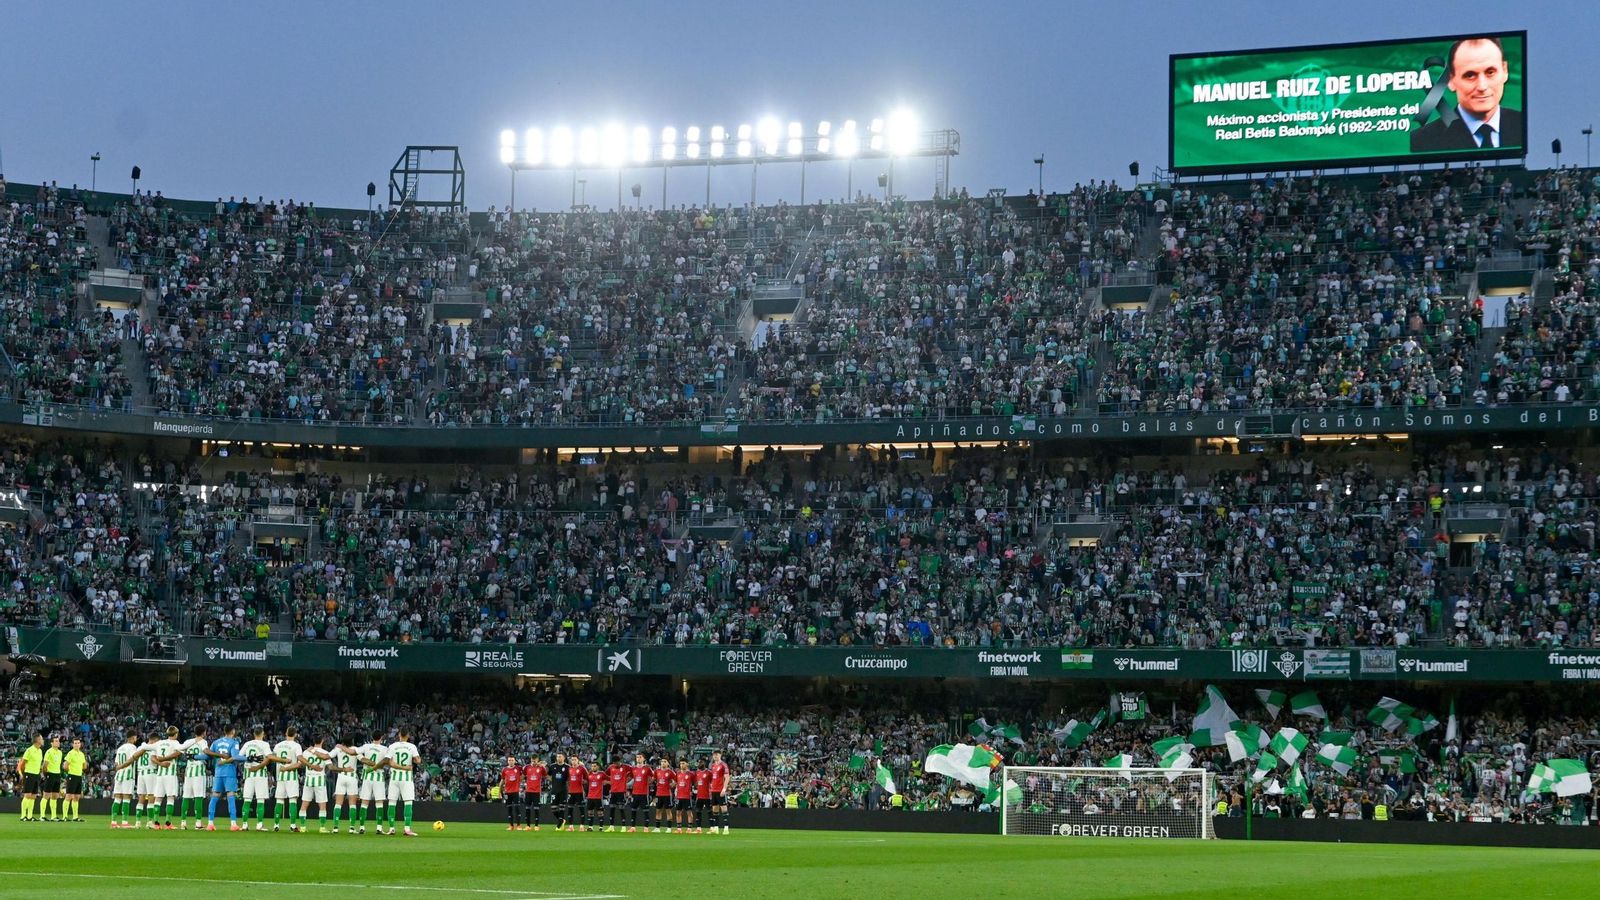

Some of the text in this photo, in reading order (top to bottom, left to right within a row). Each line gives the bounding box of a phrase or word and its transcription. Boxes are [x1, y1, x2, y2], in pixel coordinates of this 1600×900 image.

[1193, 70, 1432, 103] MANUEL RUIZ DE LOPERA
[1207, 103, 1419, 126] Máximo accionista y Presidente del
[1215, 118, 1410, 141] Real Betis Balompié (1992-2010)
[153, 421, 213, 434] Manquepierda
[896, 422, 1016, 438] Apiñados
[1038, 423, 1099, 434] como
[1122, 419, 1193, 432] balas
[1520, 409, 1561, 423] del
[220, 648, 266, 661] hummel
[338, 646, 399, 657] finetwork
[720, 650, 772, 662] FOREVER
[978, 651, 1041, 663] finetwork
[350, 660, 366, 669] FIBRA
[370, 658, 386, 670] MÓVIL
[728, 663, 763, 673] GREEN
[845, 656, 907, 670] Cruzcampo
[1130, 658, 1178, 671] hummel
[1416, 659, 1468, 672] hummel
[990, 666, 1007, 676] FIBRA
[1012, 665, 1029, 676] MÓVIL
[1563, 669, 1581, 678] FIBRA
[342, 755, 350, 768] 2
[395, 752, 409, 766] 12
[1052, 824, 1169, 838] FOREVER GREEN
